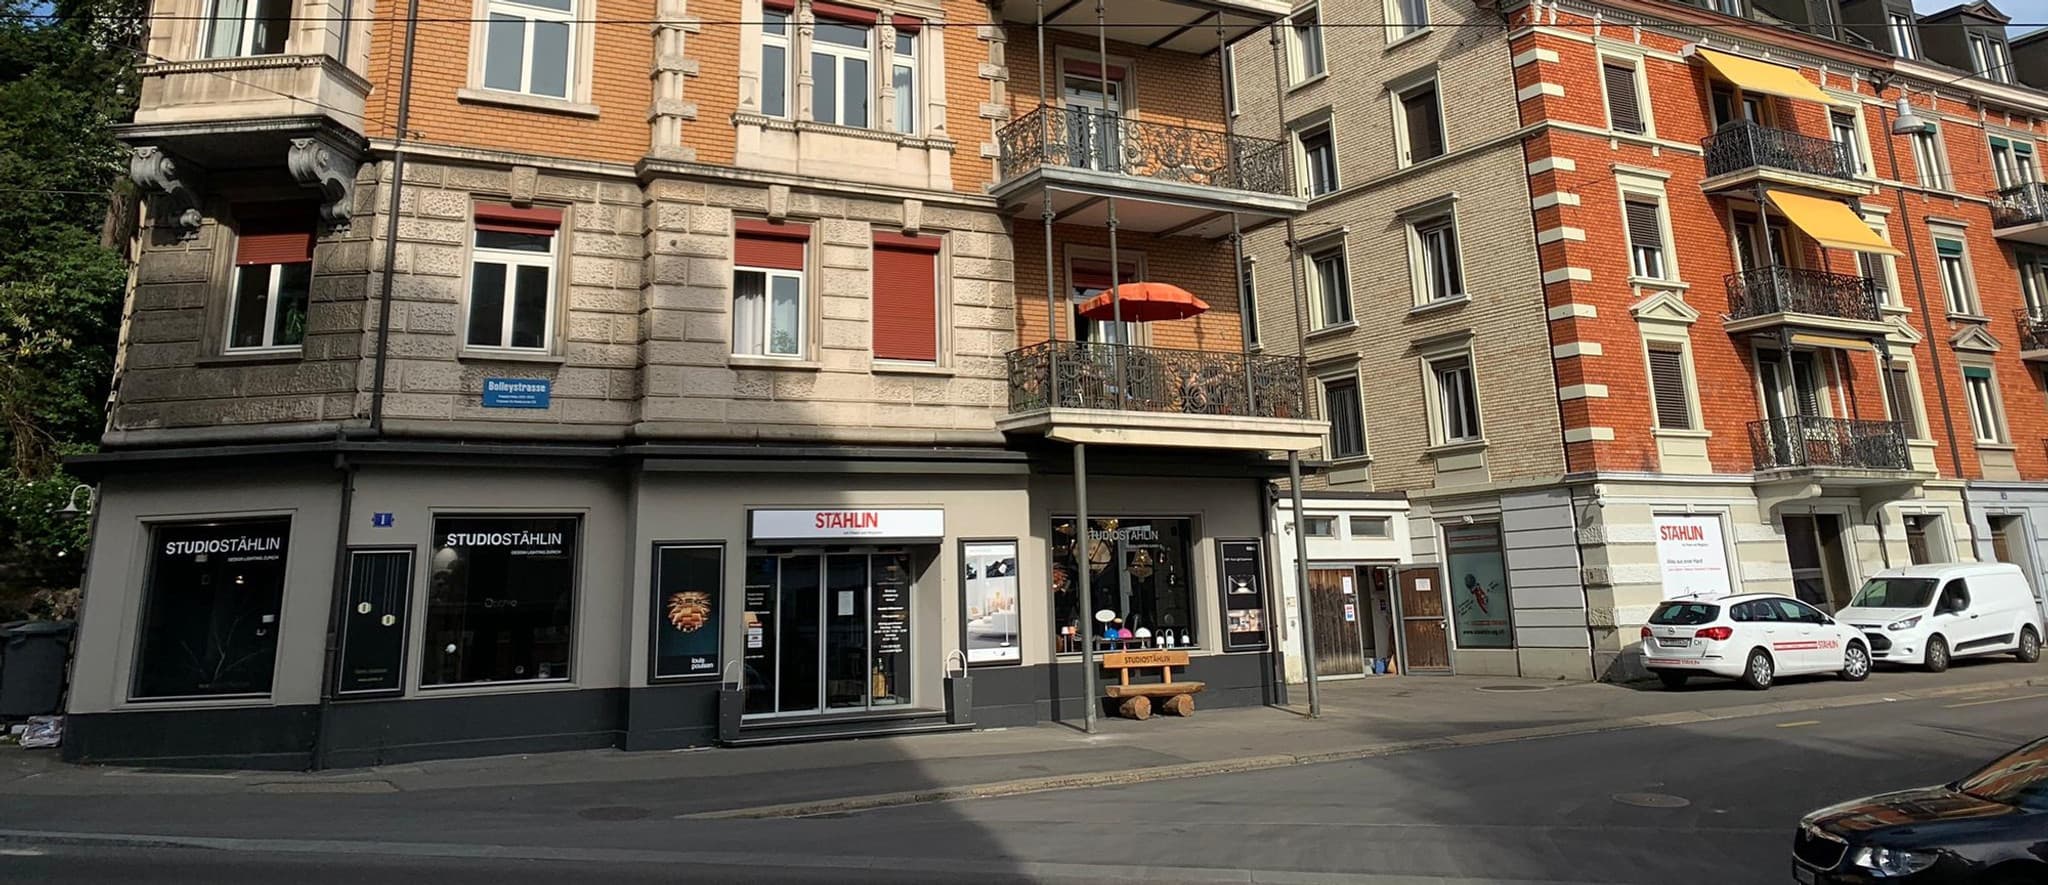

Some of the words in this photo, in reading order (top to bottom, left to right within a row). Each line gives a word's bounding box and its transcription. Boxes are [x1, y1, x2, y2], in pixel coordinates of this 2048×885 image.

[488, 381, 546, 393] Bolleystrasse
[815, 512, 878, 528] STÄHLIN
[166, 536, 280, 555] STUDIOSTÄHLIN
[447, 531, 562, 546] STUDIOSTÄHLIN
